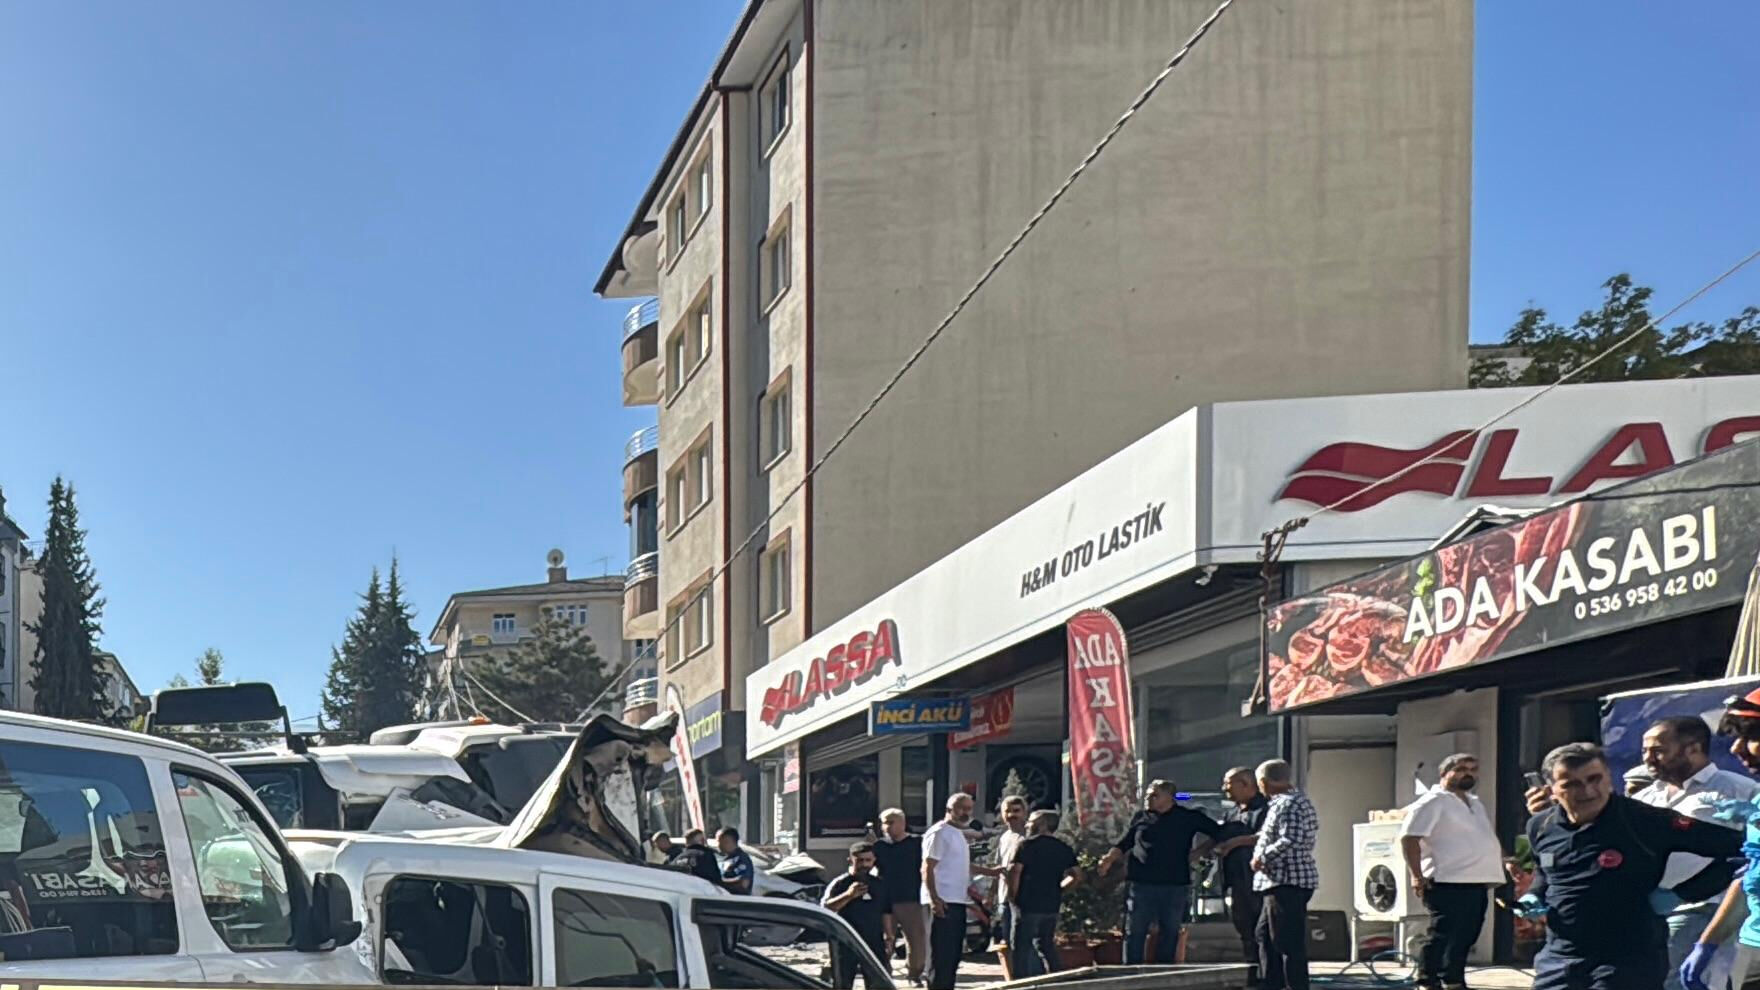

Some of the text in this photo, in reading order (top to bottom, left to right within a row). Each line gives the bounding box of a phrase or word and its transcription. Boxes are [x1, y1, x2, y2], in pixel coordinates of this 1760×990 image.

[1020, 502, 1166, 598] H&M OTO LASTİK
[1402, 505, 1717, 643] ADA KASABI
[1575, 568, 1717, 620] 0 536 958 42 00
[781, 618, 902, 716] LASSA
